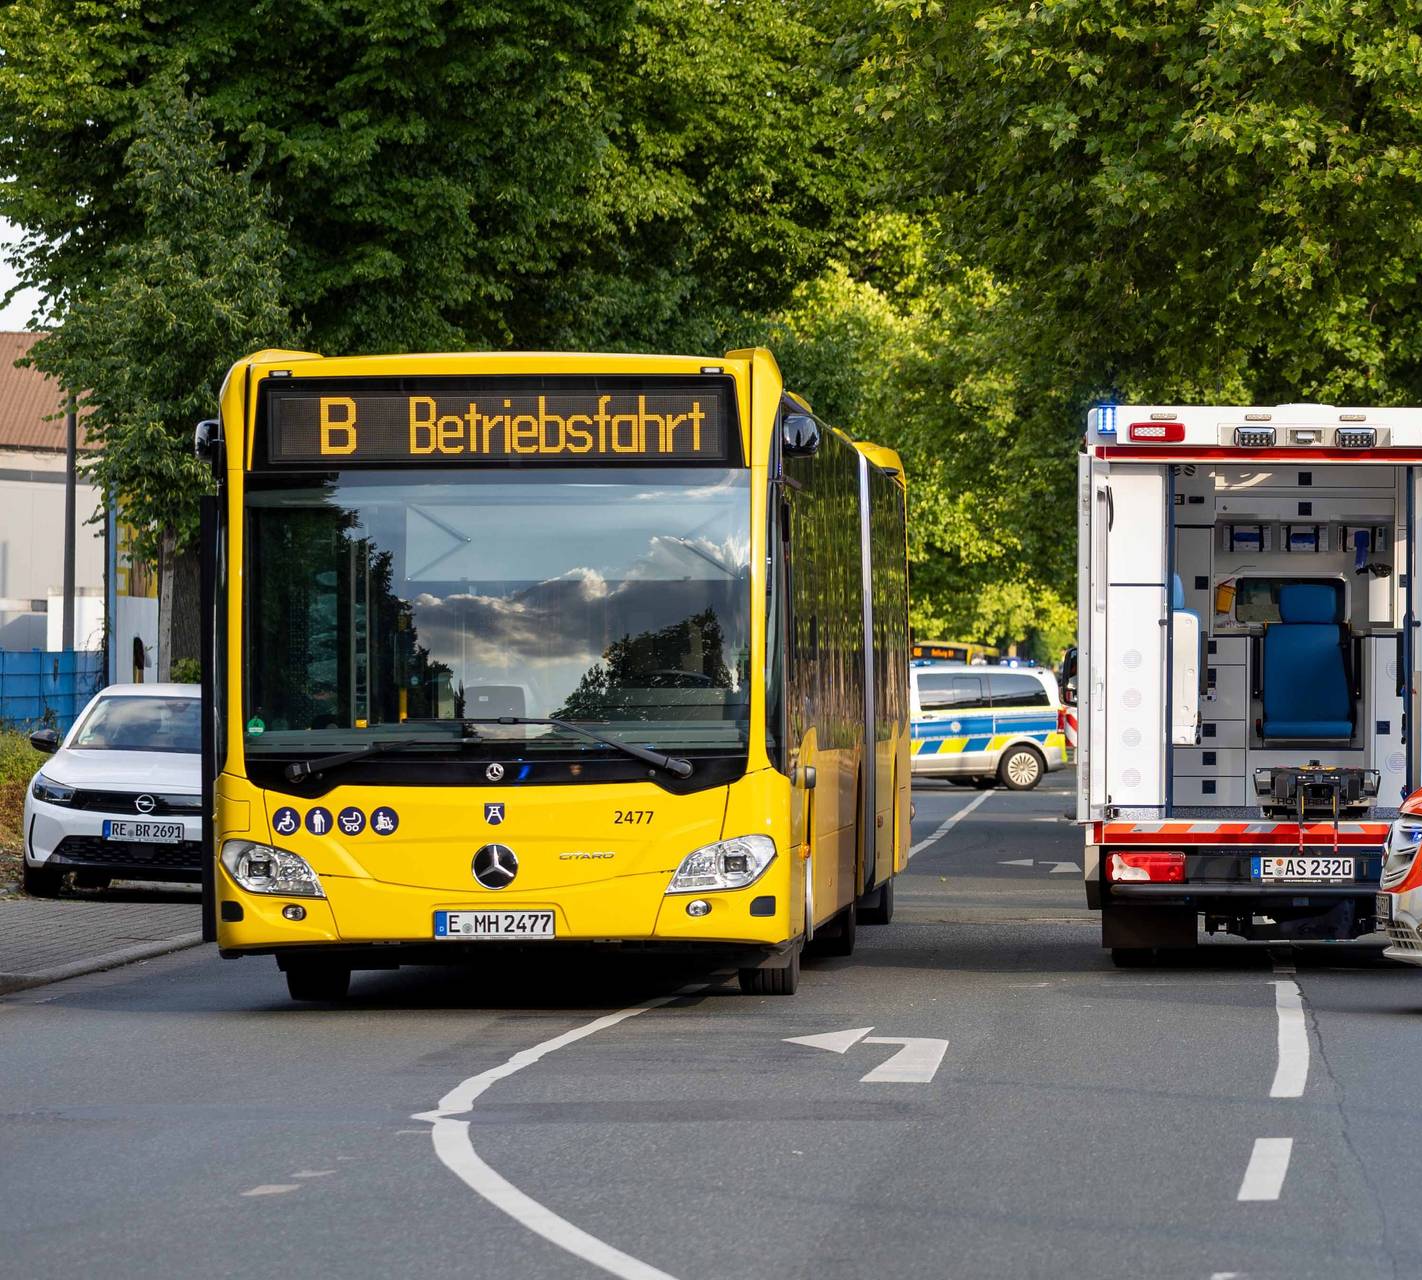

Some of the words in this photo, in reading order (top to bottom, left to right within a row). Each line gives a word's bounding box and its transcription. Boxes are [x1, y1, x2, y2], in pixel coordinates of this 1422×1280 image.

[320, 396, 357, 455] B
[409, 395, 706, 455] Betriebsfahrt
[614, 810, 654, 825] 2477
[112, 823, 127, 836] RE
[135, 824, 151, 837] BR
[153, 825, 182, 839] 2691
[559, 851, 616, 860] CITARO
[1263, 859, 1273, 876] E
[1285, 859, 1307, 876] AS
[1310, 859, 1352, 876] 2320
[448, 914, 461, 933] E
[474, 914, 499, 933] MH
[504, 914, 551, 933] 2477
